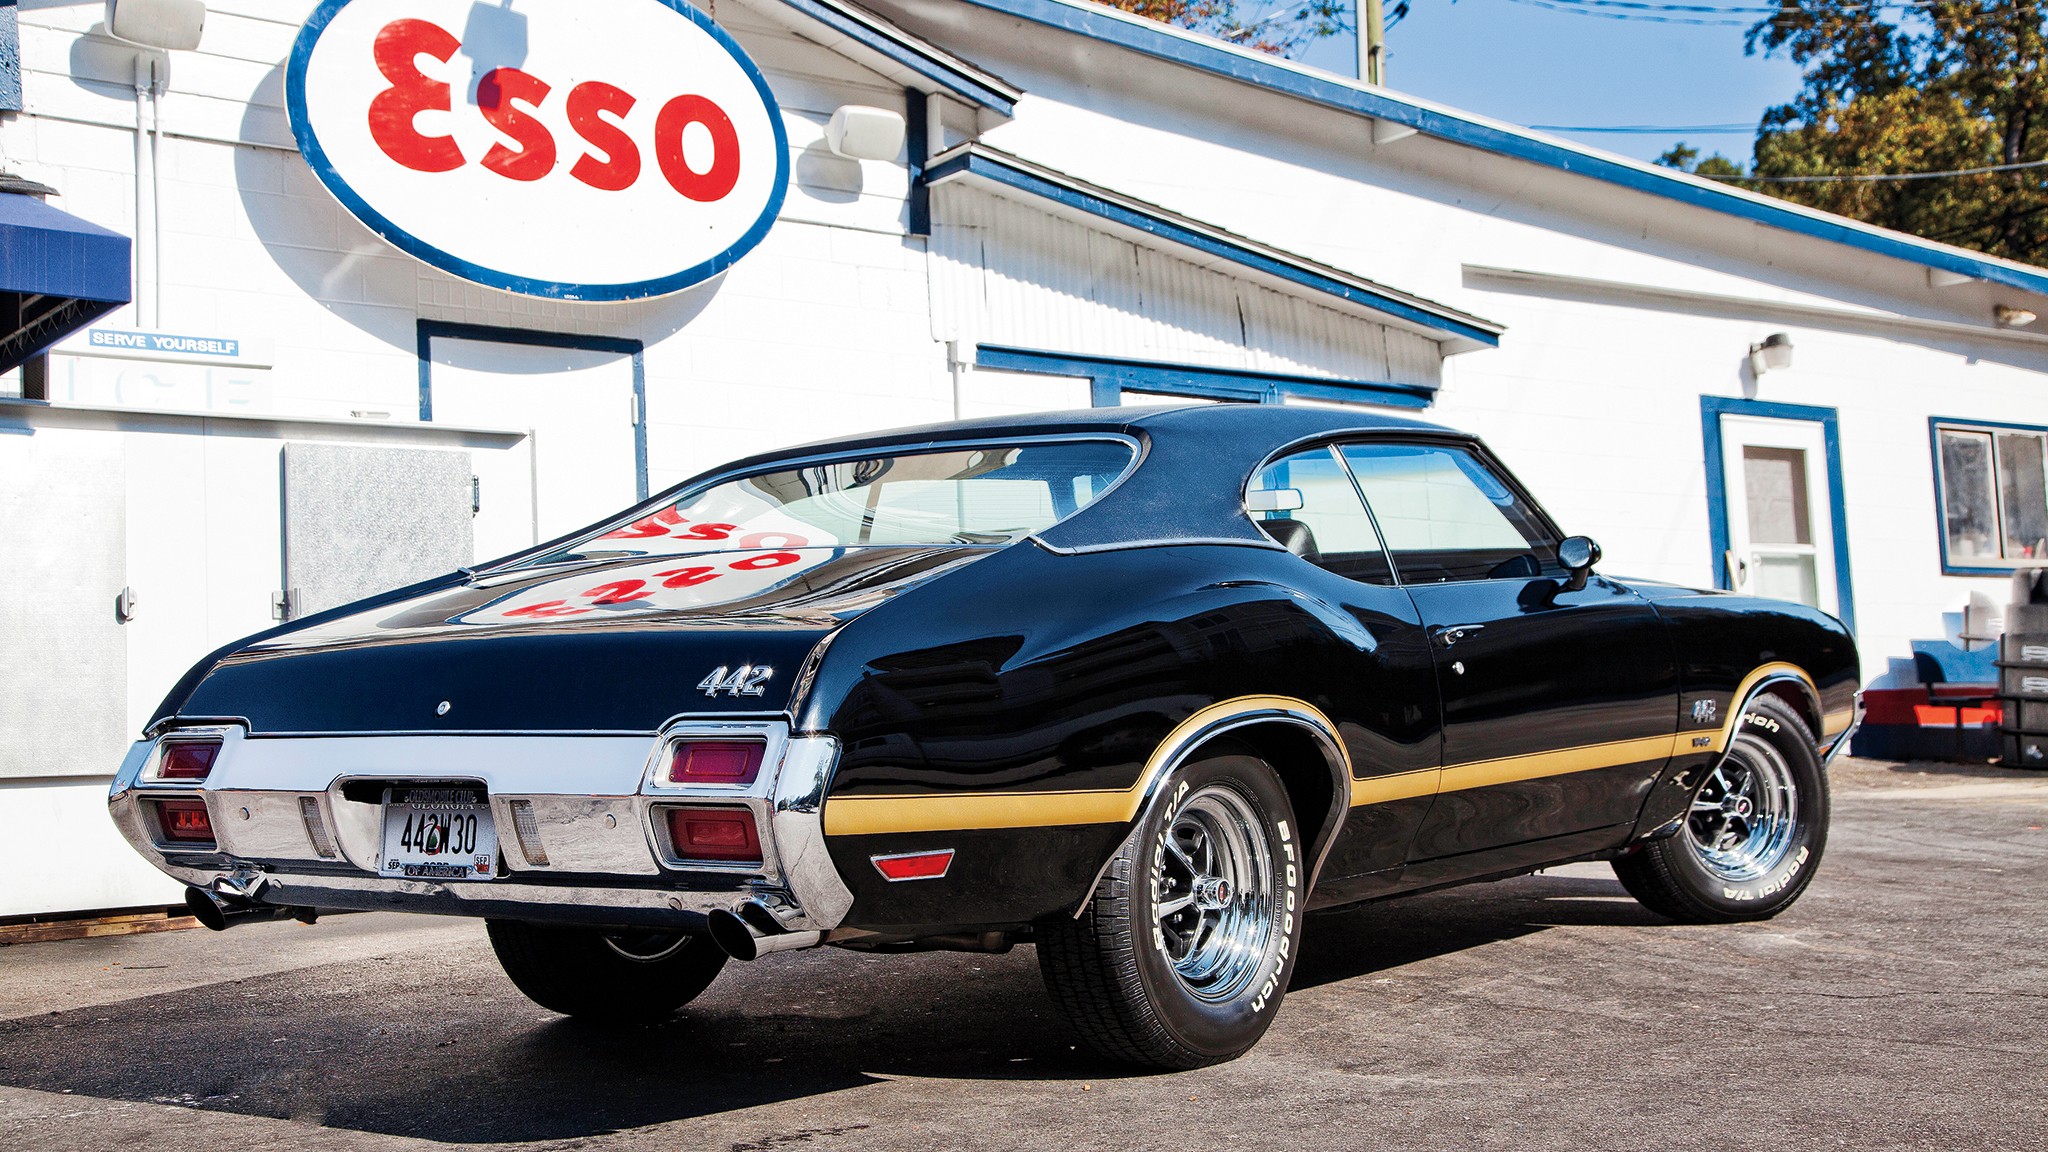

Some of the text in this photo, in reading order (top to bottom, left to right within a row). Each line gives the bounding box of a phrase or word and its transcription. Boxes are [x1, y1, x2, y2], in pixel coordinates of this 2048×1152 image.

[92, 332, 235, 354] SERVE YOURSELF
[696, 664, 775, 698] 442
[409, 790, 454, 803] OLDSMOBILE
[401, 813, 478, 854] 442W30
[388, 861, 400, 870] SEP
[407, 866, 421, 876] OF
[422, 867, 465, 877] AMERICA
[475, 857, 487, 865] SEP
[1151, 780, 1189, 950] Radial T/A
[1723, 846, 1809, 901] Radial T/A
